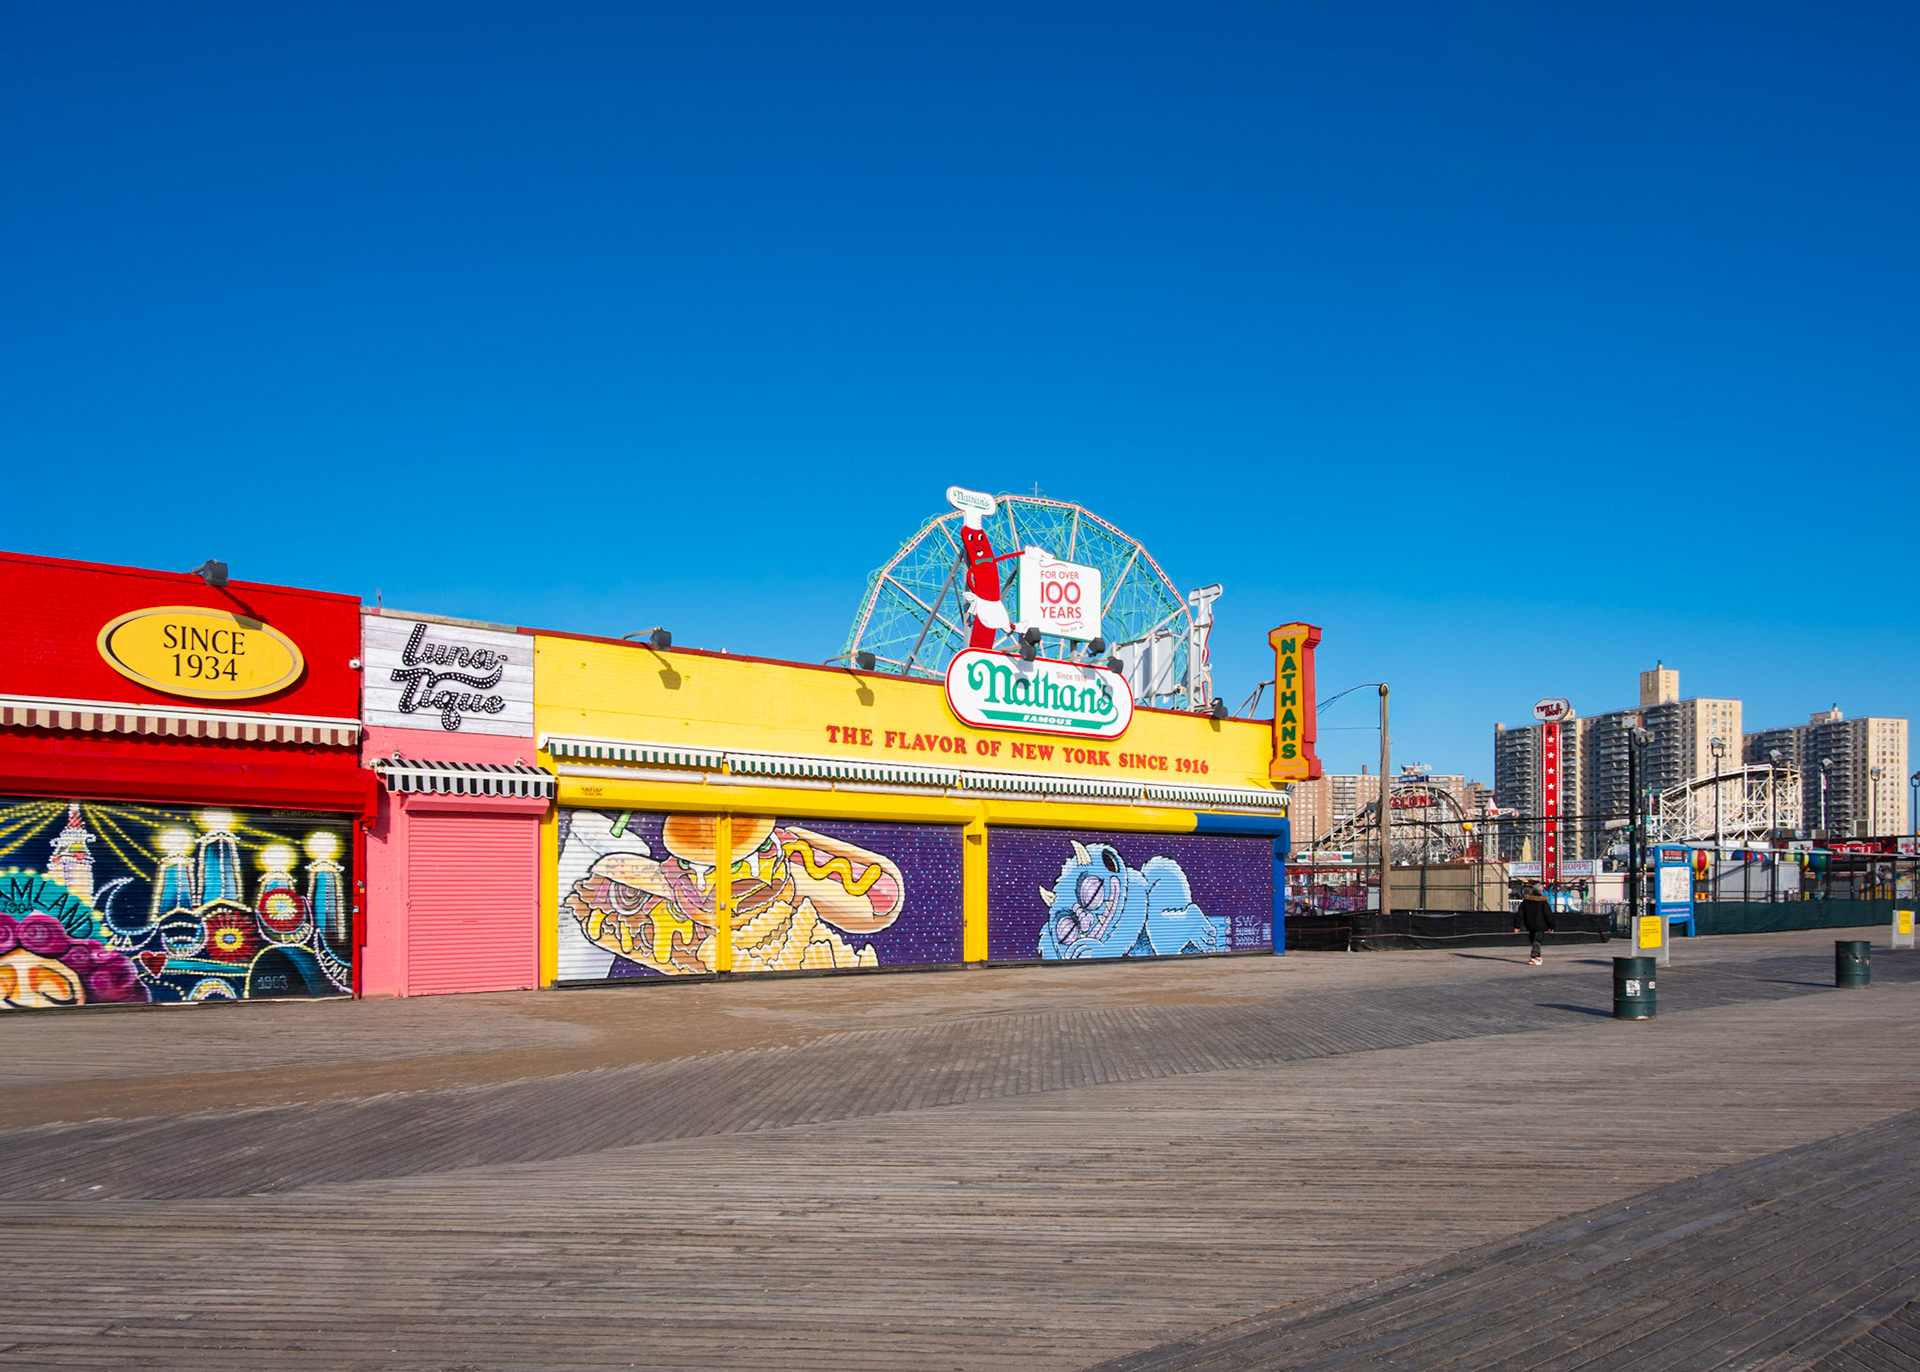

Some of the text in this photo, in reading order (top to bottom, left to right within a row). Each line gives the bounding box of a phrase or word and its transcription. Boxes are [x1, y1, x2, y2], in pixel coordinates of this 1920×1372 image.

[1040, 571, 1079, 580] FOR OVER
[1040, 581, 1081, 604] 100
[1040, 606, 1082, 619] YEARS
[163, 624, 246, 656] SINCE
[173, 653, 238, 681] 1934
[1056, 671, 1073, 680] Since
[967, 659, 1113, 715] Nathan's
[1281, 638, 1297, 759] NATHANS
[1023, 714, 1072, 726] FAMOUS
[826, 725, 1209, 774] THE FLAVOR OF NEW YORK SINCE 1916
[1561, 863, 1589, 871] HOPPE
[319, 949, 349, 986] LUNA
